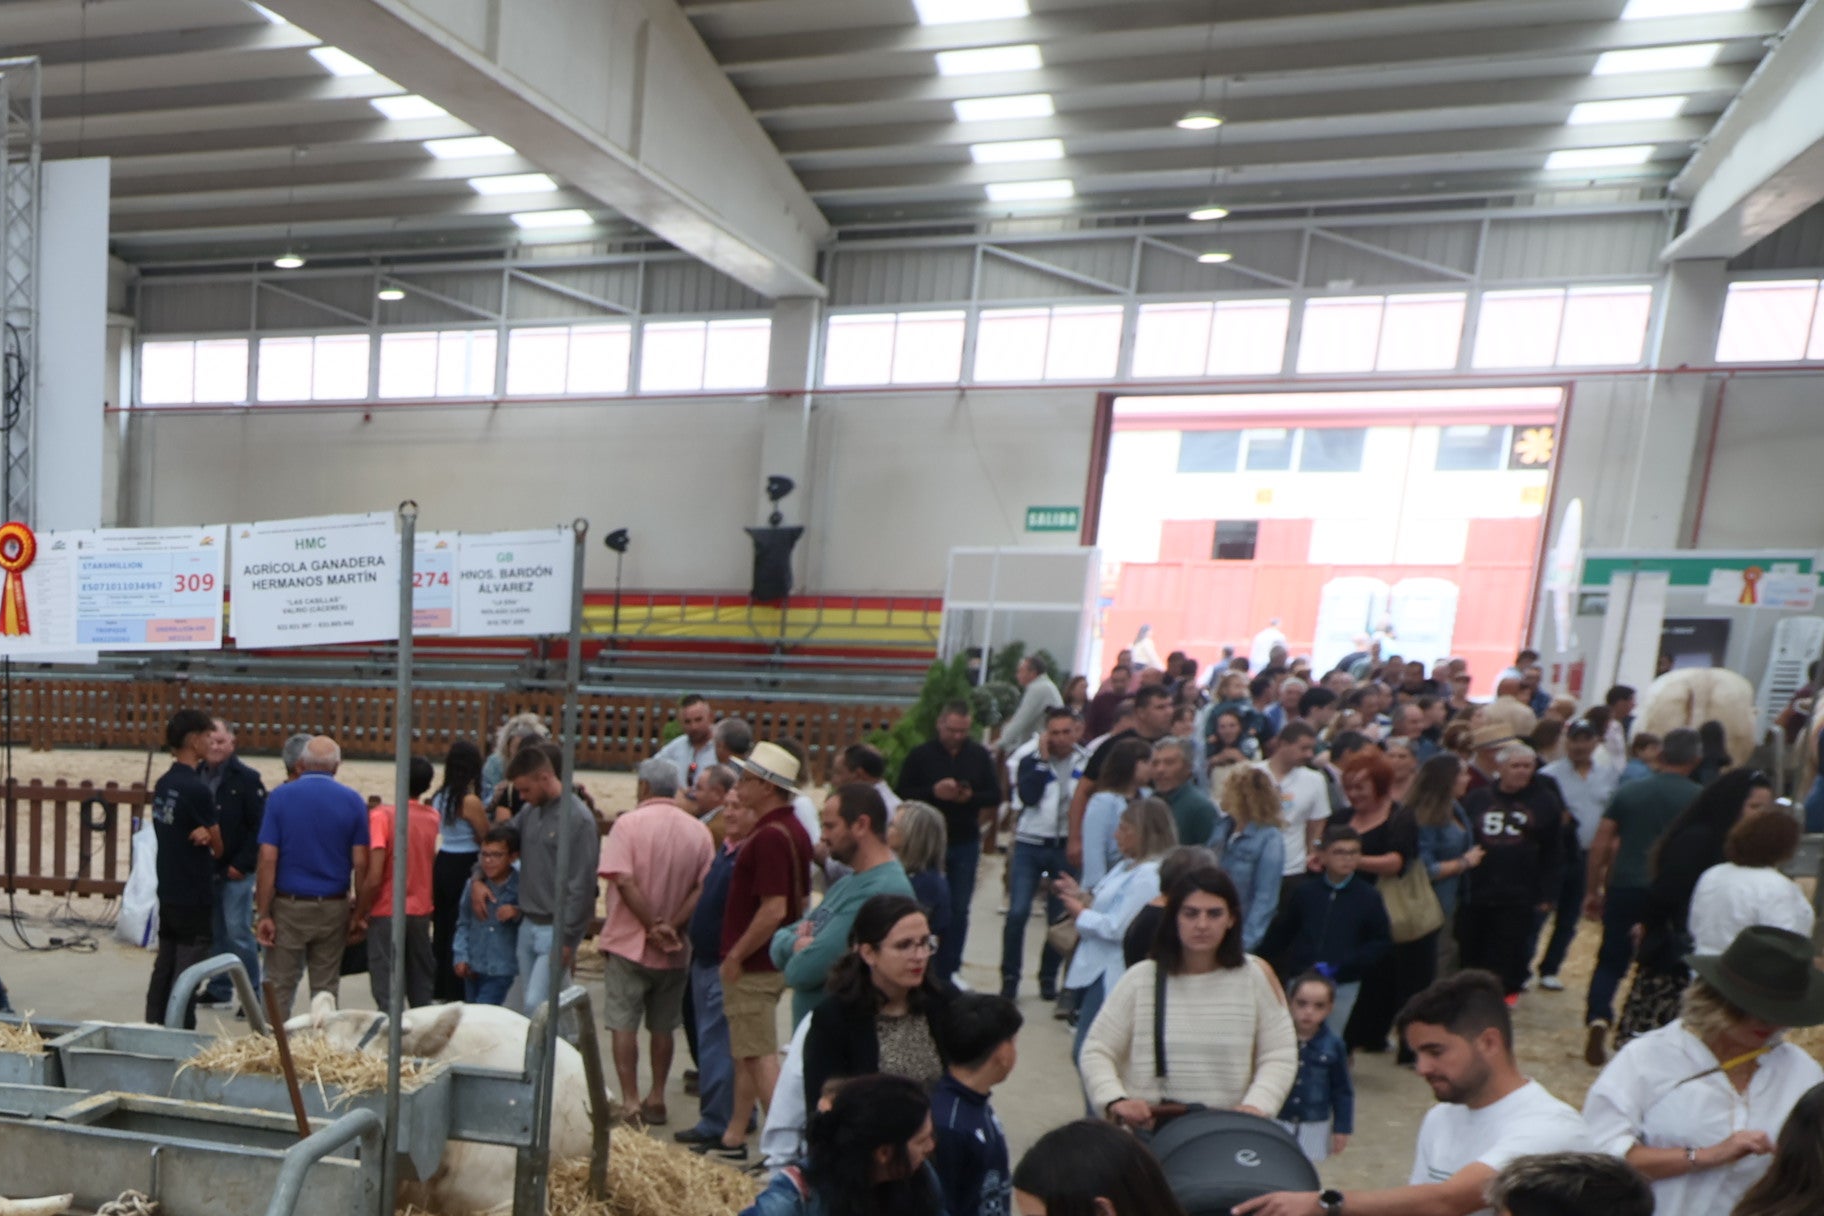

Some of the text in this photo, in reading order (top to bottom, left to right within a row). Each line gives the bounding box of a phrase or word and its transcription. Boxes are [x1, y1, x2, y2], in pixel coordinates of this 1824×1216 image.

[1028, 511, 1077, 527] SALIDA
[295, 537, 327, 550] HMC
[244, 556, 386, 575] AGRÍCOLA GANADERA
[500, 566, 553, 579] BARDÓN
[174, 573, 215, 592] 309
[253, 571, 377, 590] HERMANOS MARTÍN
[413, 571, 450, 588] 274
